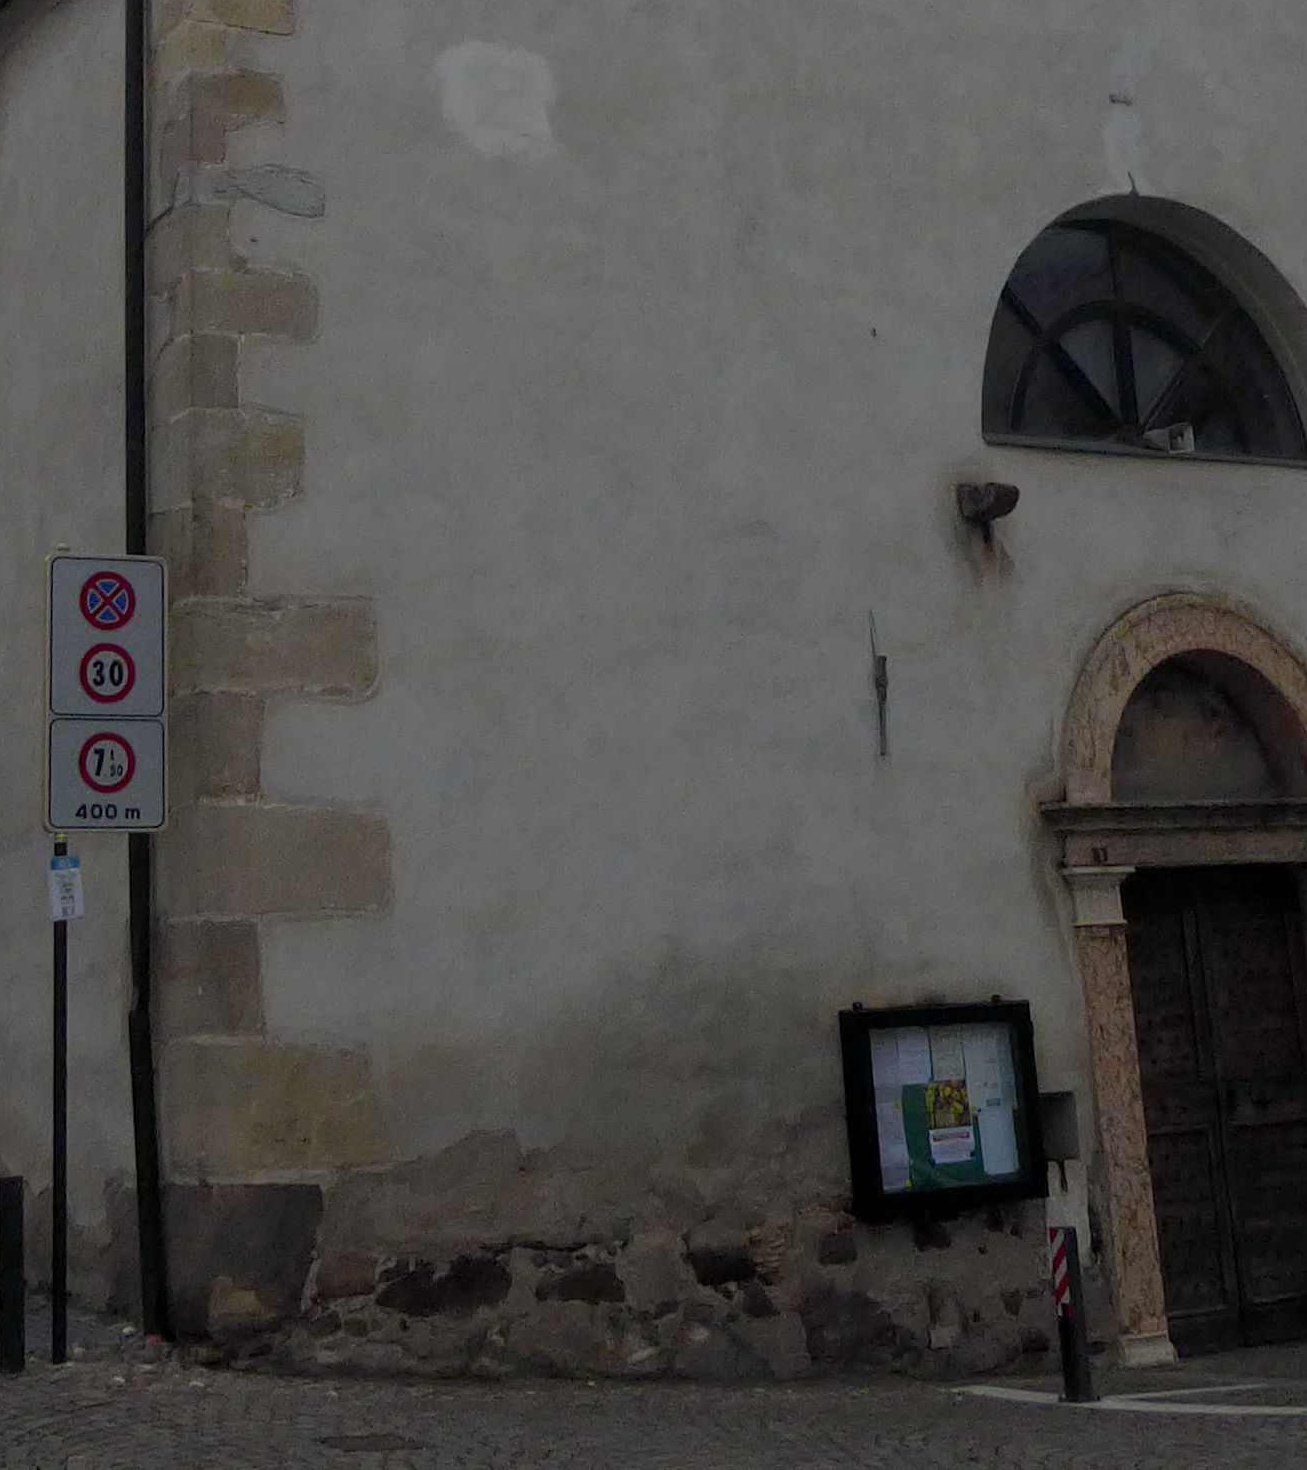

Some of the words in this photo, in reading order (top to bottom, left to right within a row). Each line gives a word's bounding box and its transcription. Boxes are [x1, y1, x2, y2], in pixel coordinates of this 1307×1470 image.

[93, 659, 123, 687] 30
[75, 803, 118, 820] 400
[125, 808, 141, 820] m
